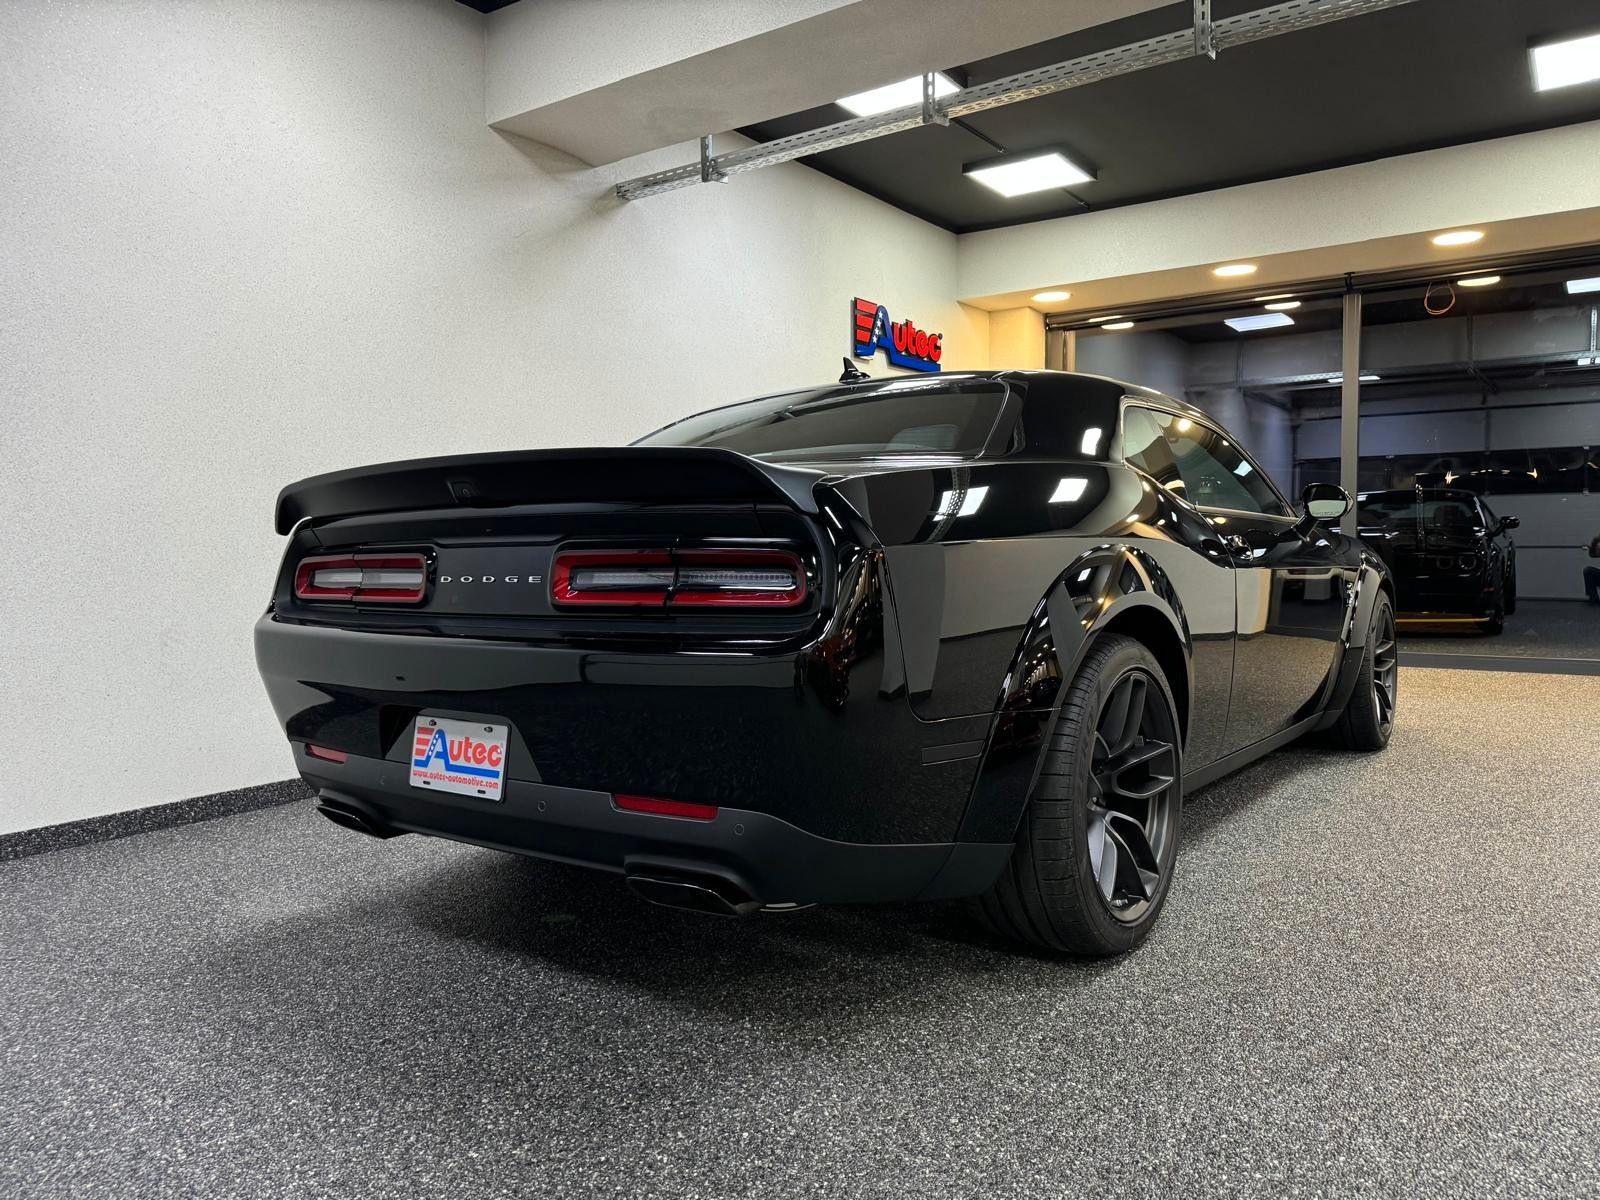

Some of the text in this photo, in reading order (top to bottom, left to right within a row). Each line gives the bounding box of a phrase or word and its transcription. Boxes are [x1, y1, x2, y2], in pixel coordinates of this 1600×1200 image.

[866, 304, 942, 364] Autec
[440, 575, 543, 583] DODGE
[421, 728, 502, 770] Autec
[412, 769, 499, 789] www.autec-automotive.com
